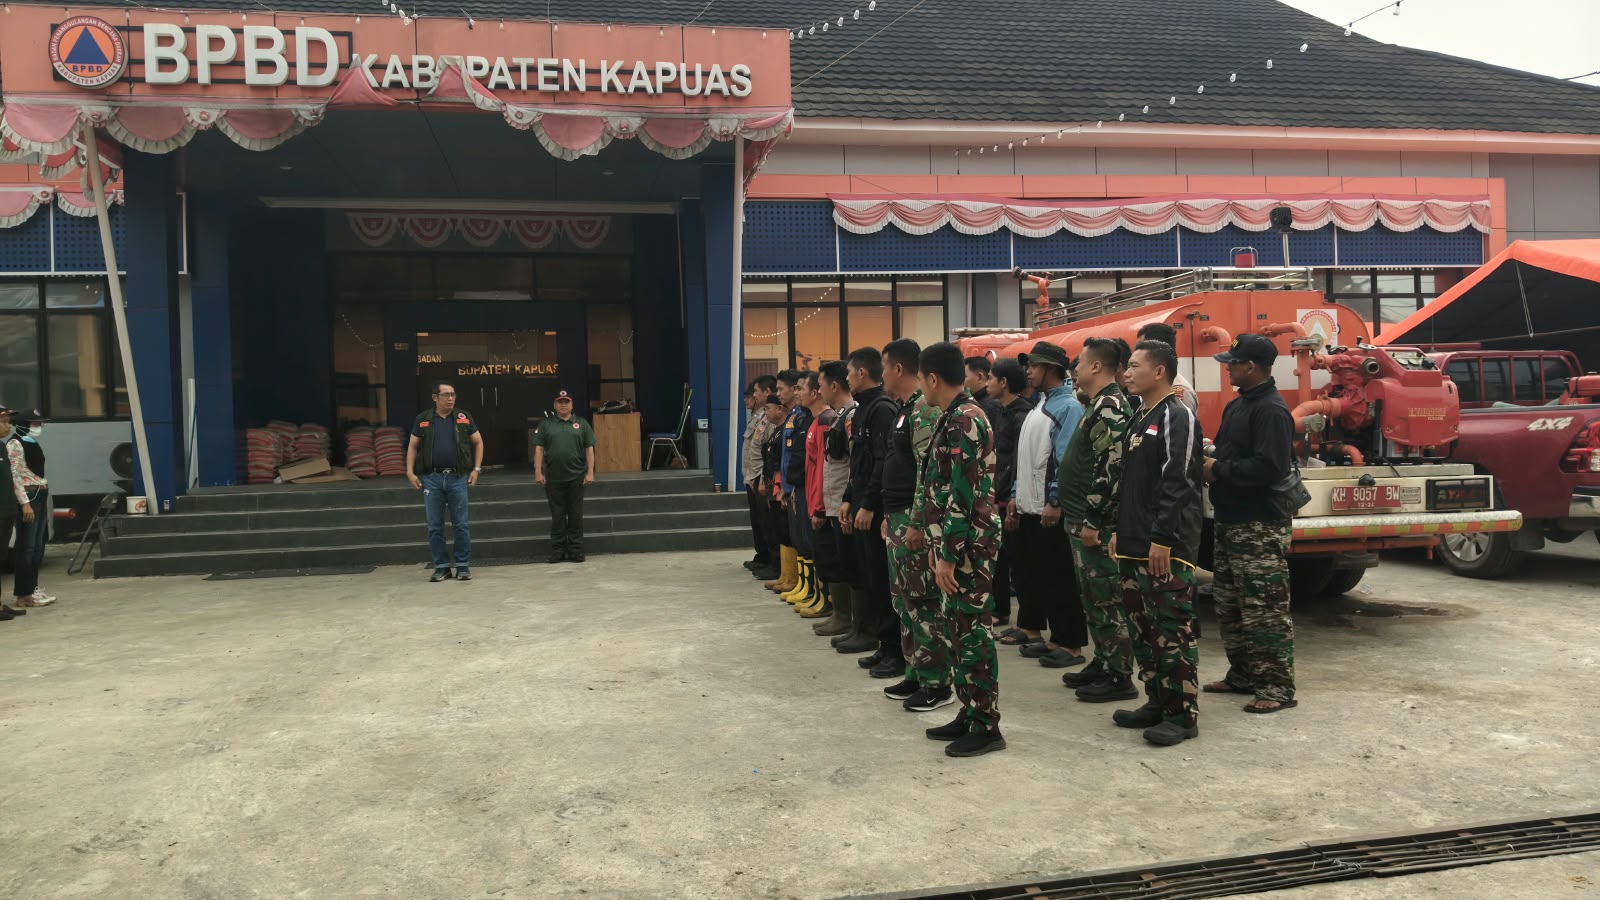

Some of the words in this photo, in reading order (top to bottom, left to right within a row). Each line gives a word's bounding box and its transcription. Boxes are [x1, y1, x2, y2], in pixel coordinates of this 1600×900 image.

[72, 65, 103, 73] BPBD
[143, 23, 340, 88] BPBD
[351, 53, 587, 93] KABPATEN
[600, 59, 753, 98] KAPUAS
[56, 63, 95, 85] KABUPATEN
[95, 64, 118, 83] KAPUAS
[1332, 487, 1347, 502] KH
[1353, 486, 1378, 502] 9057
[1386, 486, 1400, 501] BW
